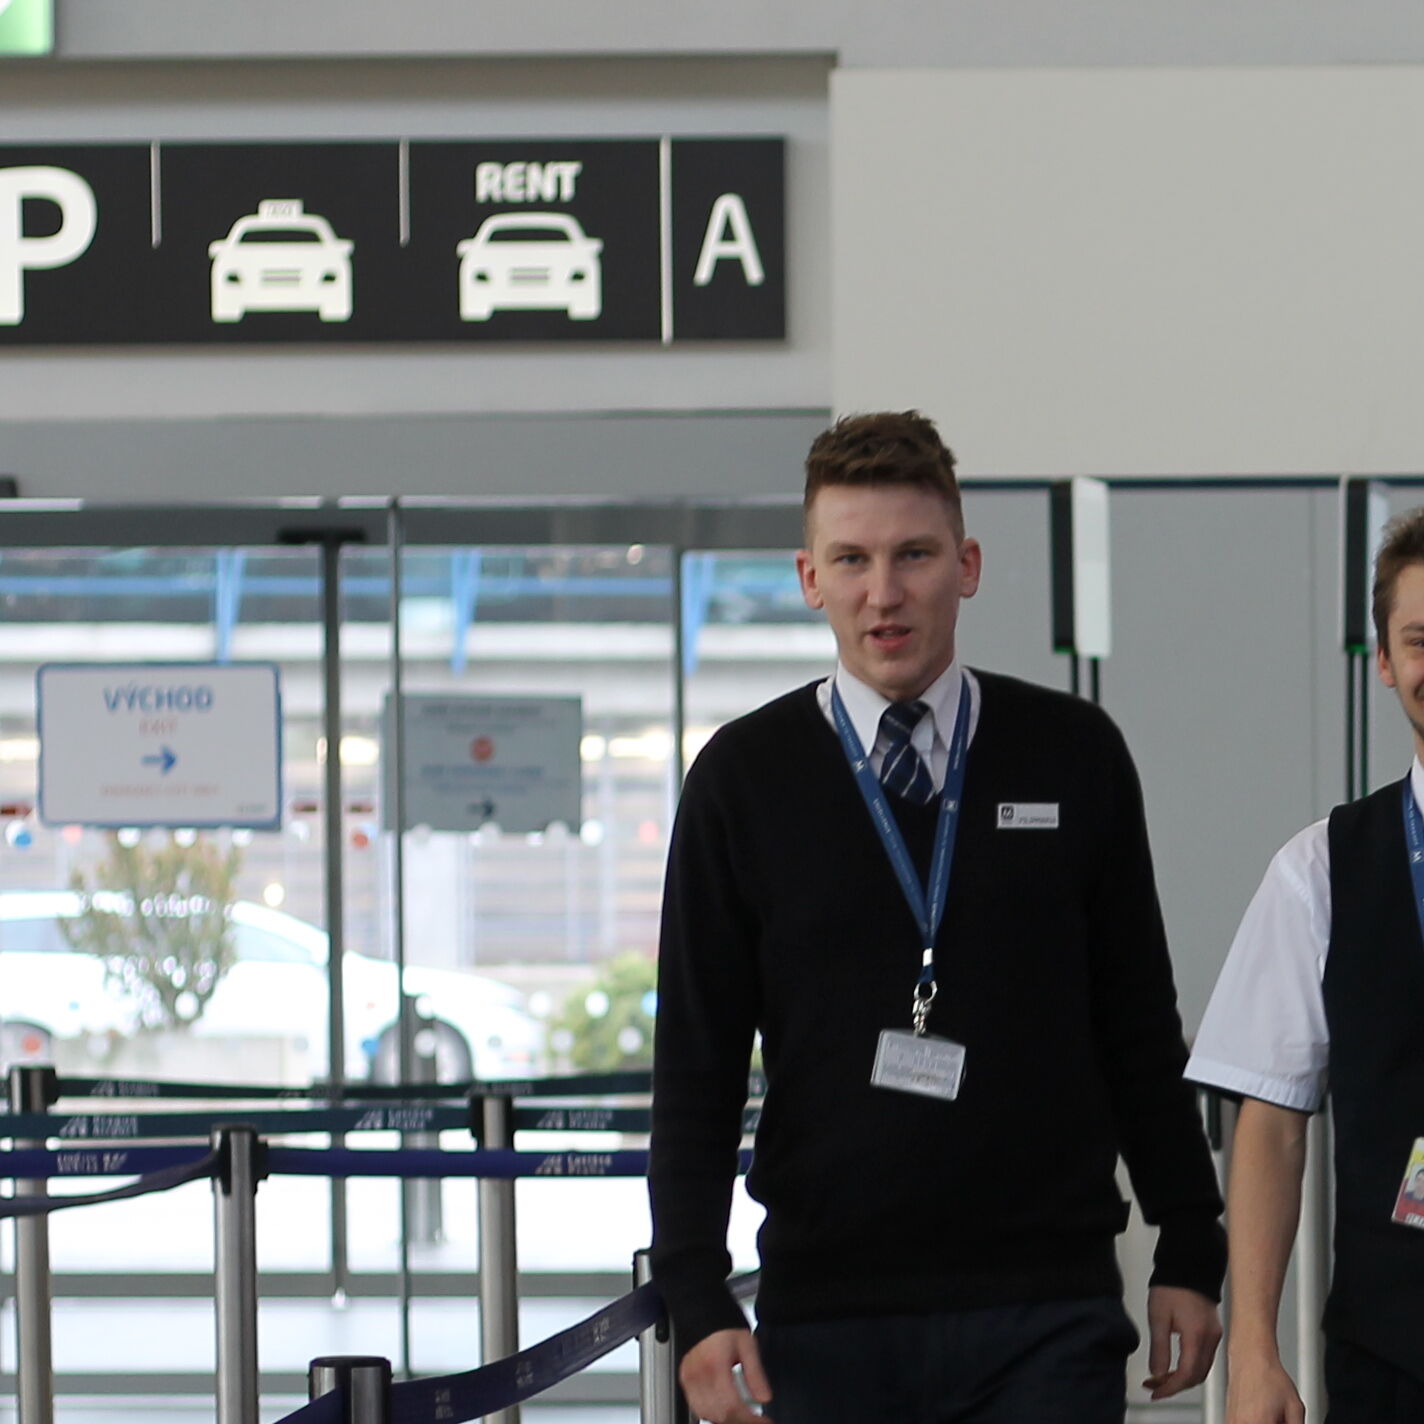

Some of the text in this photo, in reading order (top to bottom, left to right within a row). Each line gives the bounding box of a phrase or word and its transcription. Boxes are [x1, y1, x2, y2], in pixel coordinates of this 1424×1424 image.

[475, 161, 582, 204] RENT
[0, 165, 97, 326] P
[693, 192, 765, 287] A
[103, 681, 214, 713] VÝCHOD
